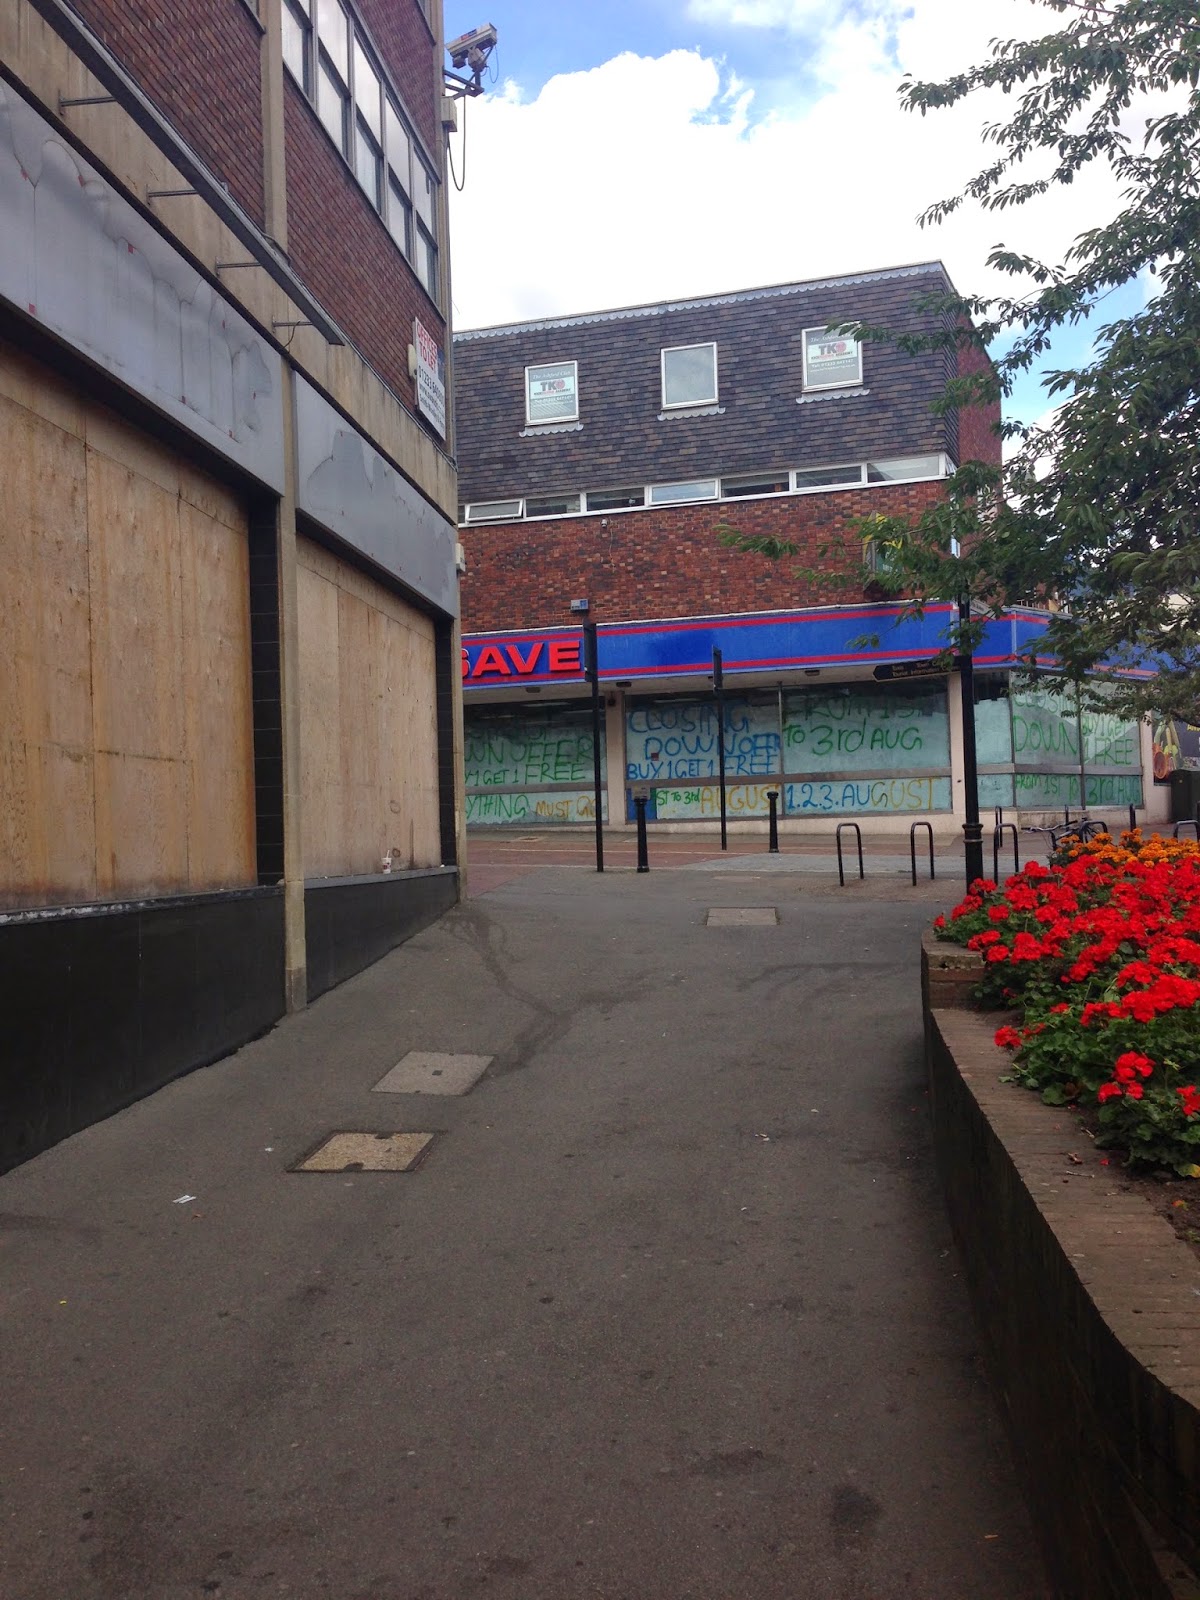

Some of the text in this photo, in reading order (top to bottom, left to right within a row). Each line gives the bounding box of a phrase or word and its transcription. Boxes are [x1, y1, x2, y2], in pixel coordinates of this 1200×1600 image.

[417, 322, 437, 356] OFFICES
[420, 341, 437, 374] TO LET
[783, 718, 923, 756] TO 3rd AUG
[1013, 715, 1077, 756] DOWN
[626, 762, 664, 781] BUY
[674, 758, 707, 777] GET
[723, 753, 778, 776] FREE
[1094, 738, 1134, 766] FREE
[482, 768, 512, 784] GET
[524, 763, 587, 785] FREE
[465, 793, 530, 819] YTHING
[535, 799, 574, 818] MUST
